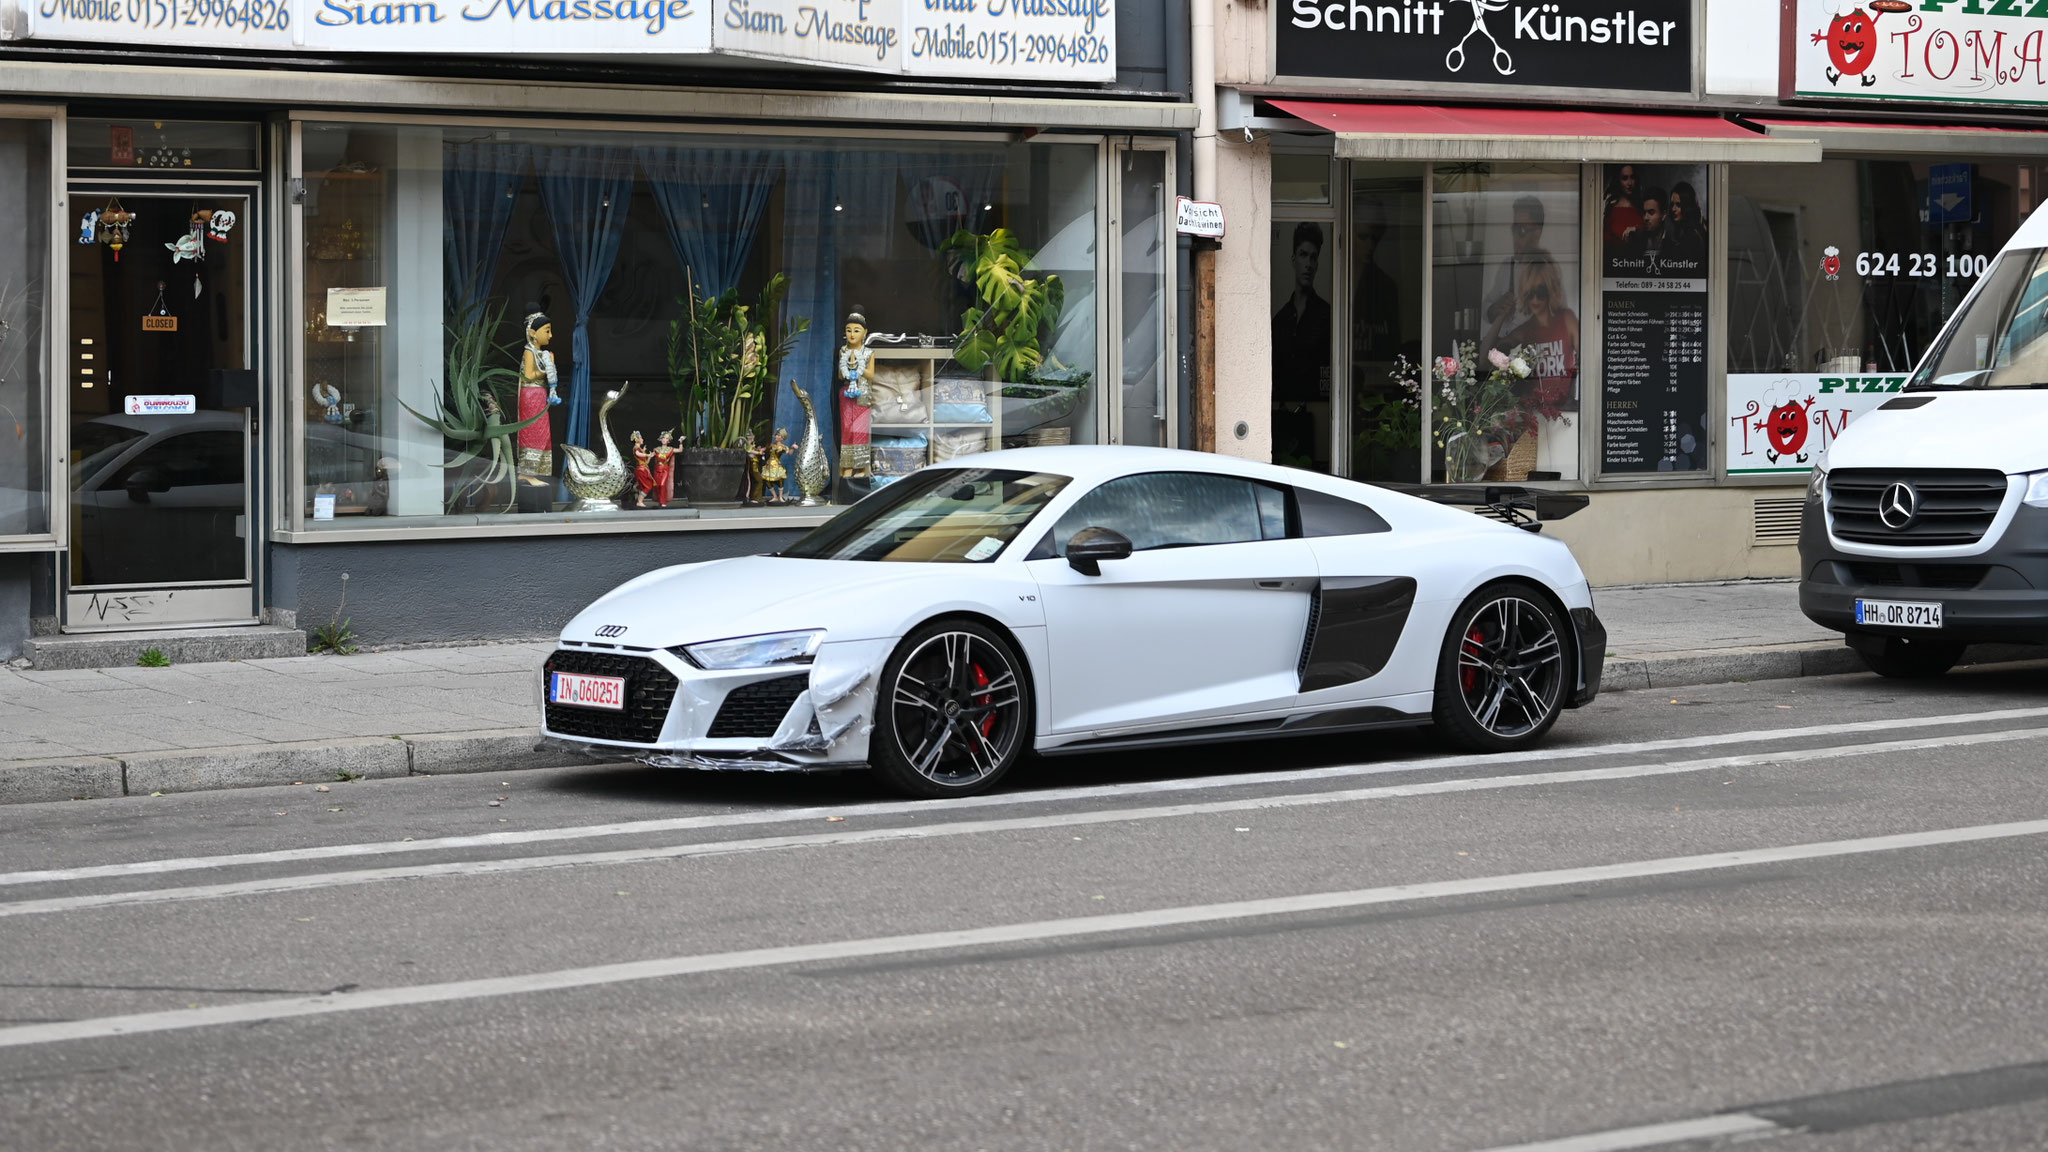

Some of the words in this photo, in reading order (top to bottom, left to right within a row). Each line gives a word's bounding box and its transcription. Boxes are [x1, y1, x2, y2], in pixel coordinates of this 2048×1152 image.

[316, 0, 446, 26] Siam
[461, 0, 694, 34] Massage
[724, 0, 787, 35] Siam
[795, 6, 898, 60] Massage
[1291, 0, 1445, 35] Schnitt
[1514, 4, 1676, 46] Künstler
[912, 22, 976, 61] Mobile
[977, 30, 1108, 67] 0151-29964826
[1891, 14, 2046, 86] TOMA
[1184, 204, 1219, 217] Vosicht
[1612, 258, 1645, 268] Schnitt
[1660, 258, 1698, 269] Künstler
[1856, 252, 1900, 276] 624
[1909, 253, 1937, 277] 23
[1946, 254, 1988, 278] 100
[1616, 281, 1640, 289] Telefon:
[146, 319, 174, 328] CLOSED
[1819, 377, 1908, 393] PIZZ
[1864, 604, 1878, 621] HH
[1888, 605, 1904, 623] OR
[1907, 606, 1940, 625] 8714
[560, 677, 572, 700] IN
[579, 679, 619, 704] 060251
